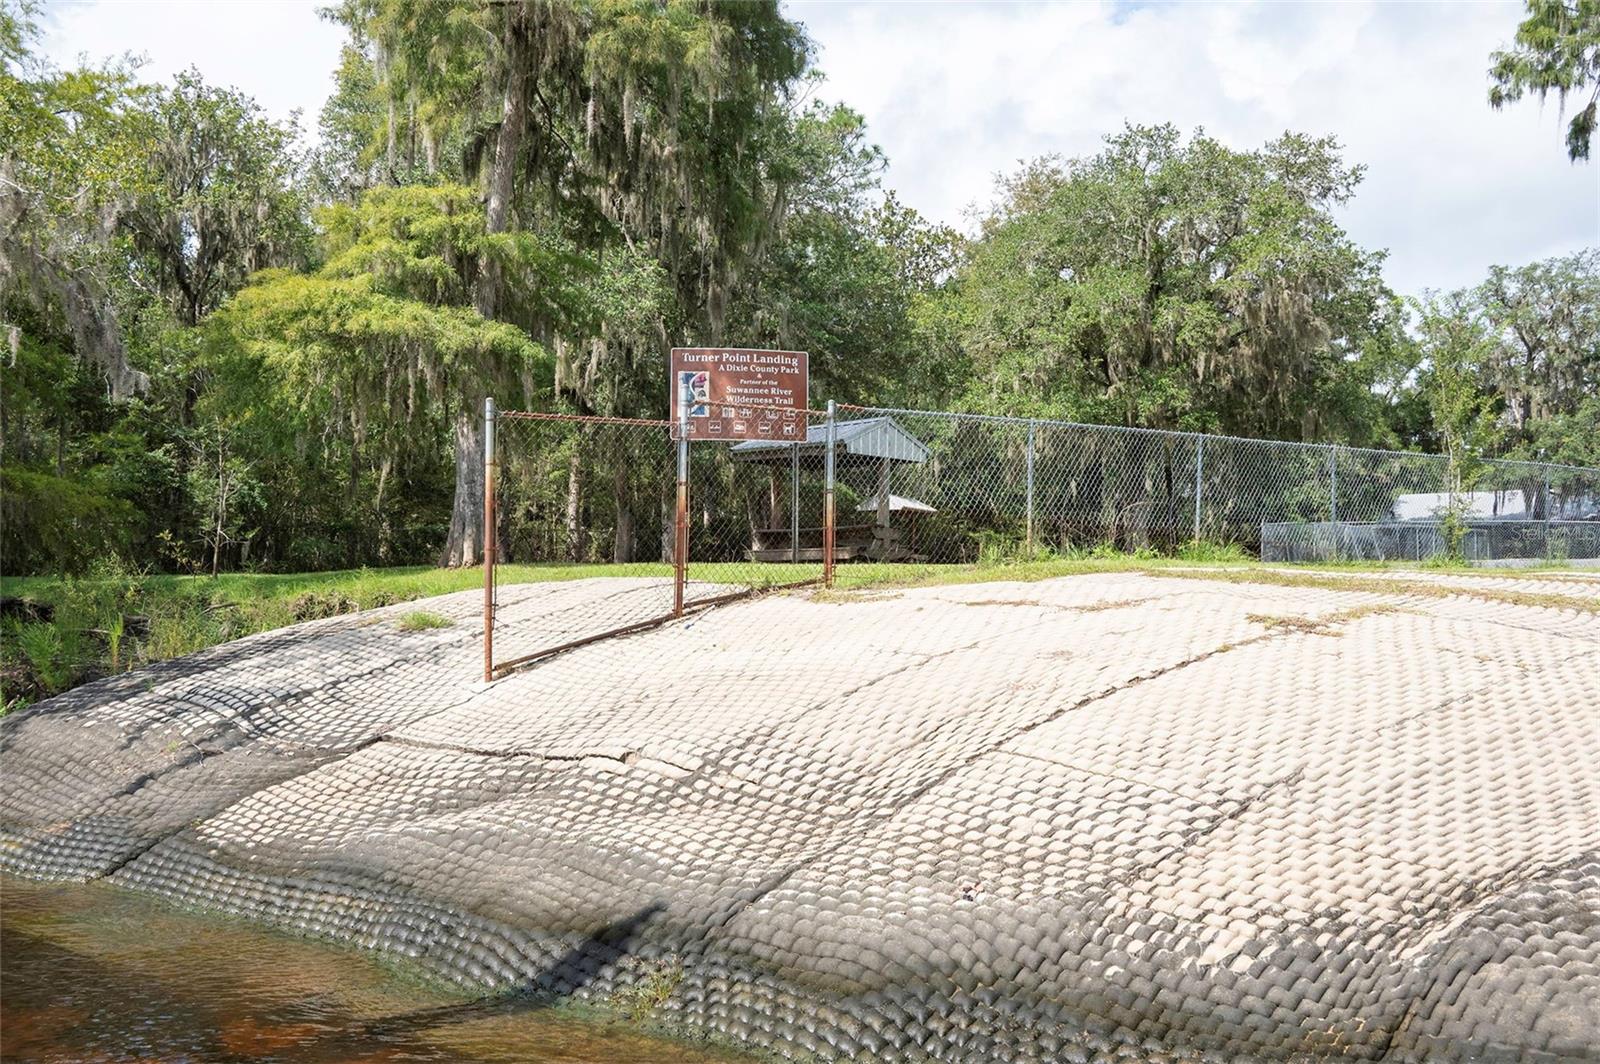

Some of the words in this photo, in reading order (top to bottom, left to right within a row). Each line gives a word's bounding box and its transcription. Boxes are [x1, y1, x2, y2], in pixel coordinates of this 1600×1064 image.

[682, 352, 719, 362] Turner
[722, 352, 750, 363] Point
[753, 354, 798, 366] Landing
[726, 364, 748, 372] Dixie
[751, 365, 779, 374] County
[726, 385, 769, 395] Suwannee
[771, 387, 793, 395] River
[726, 395, 773, 404] Wilderness
[774, 396, 794, 405] Trail
